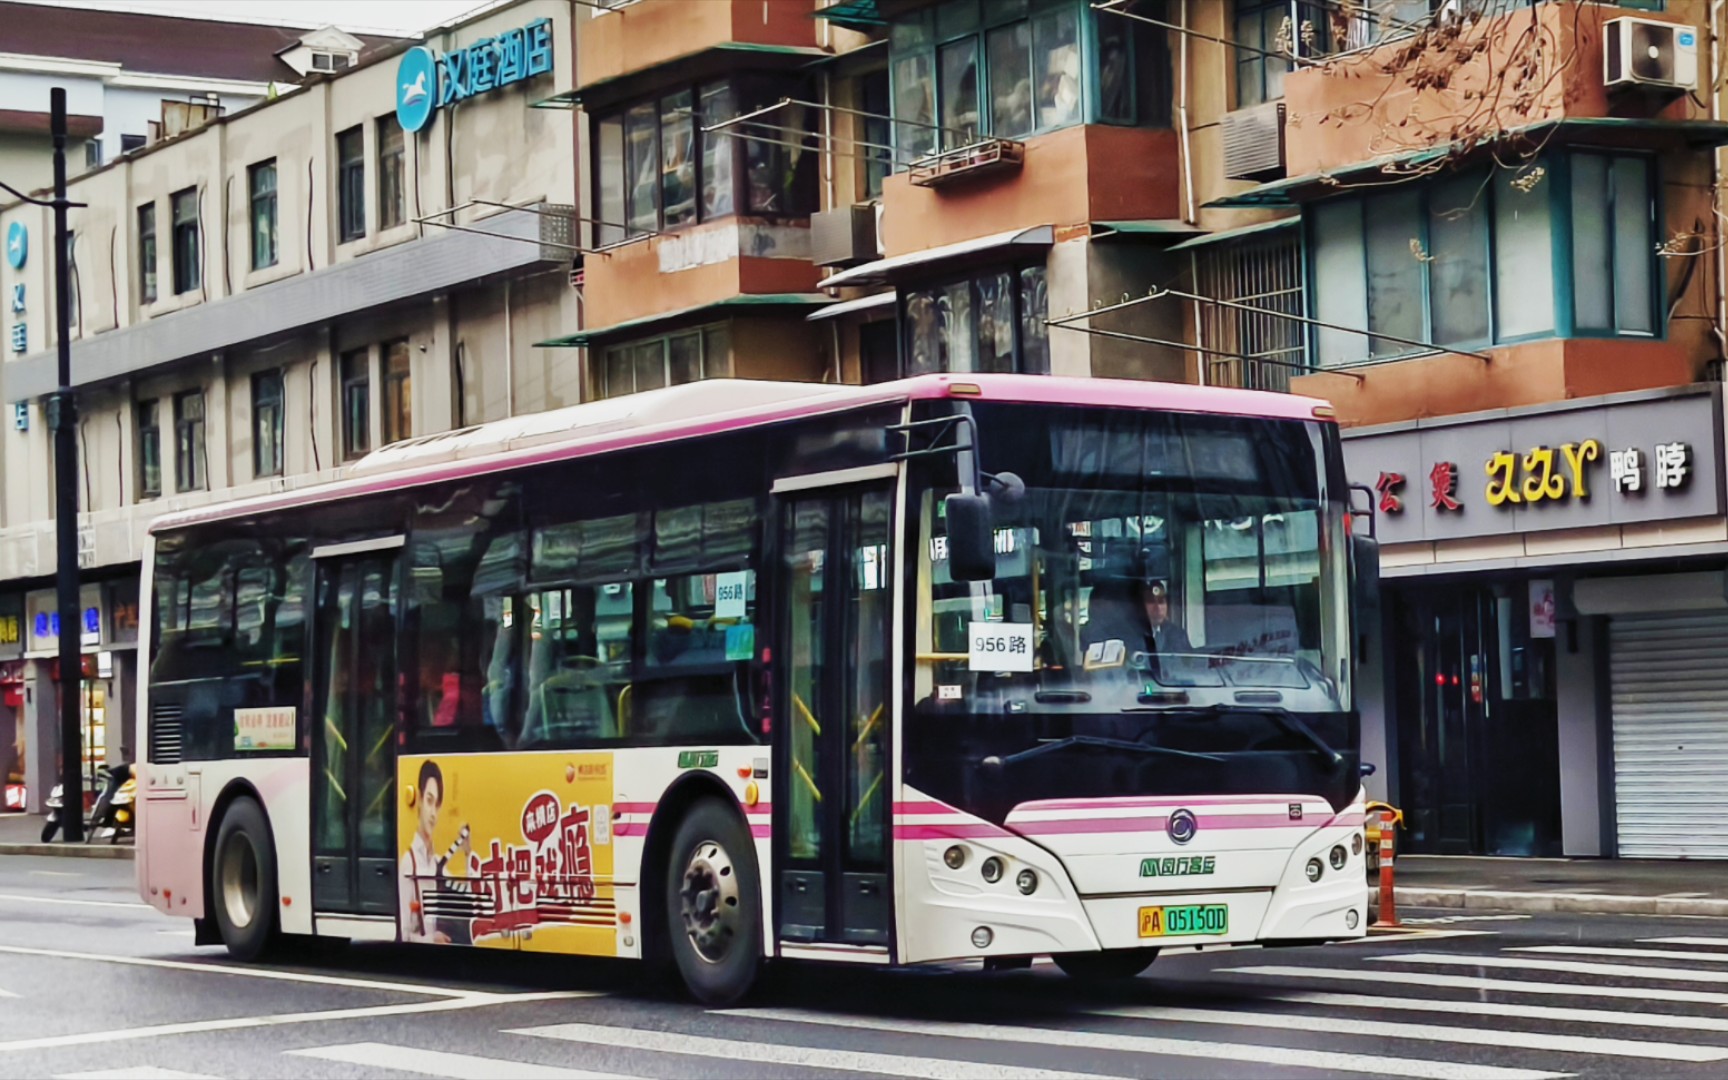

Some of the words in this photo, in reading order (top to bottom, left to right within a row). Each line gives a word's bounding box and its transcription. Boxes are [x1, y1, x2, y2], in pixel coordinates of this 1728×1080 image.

[441, 18, 553, 104] 汉庭酒店
[1609, 443, 1687, 493] 鸭脖
[976, 636, 1026, 653] 956路
